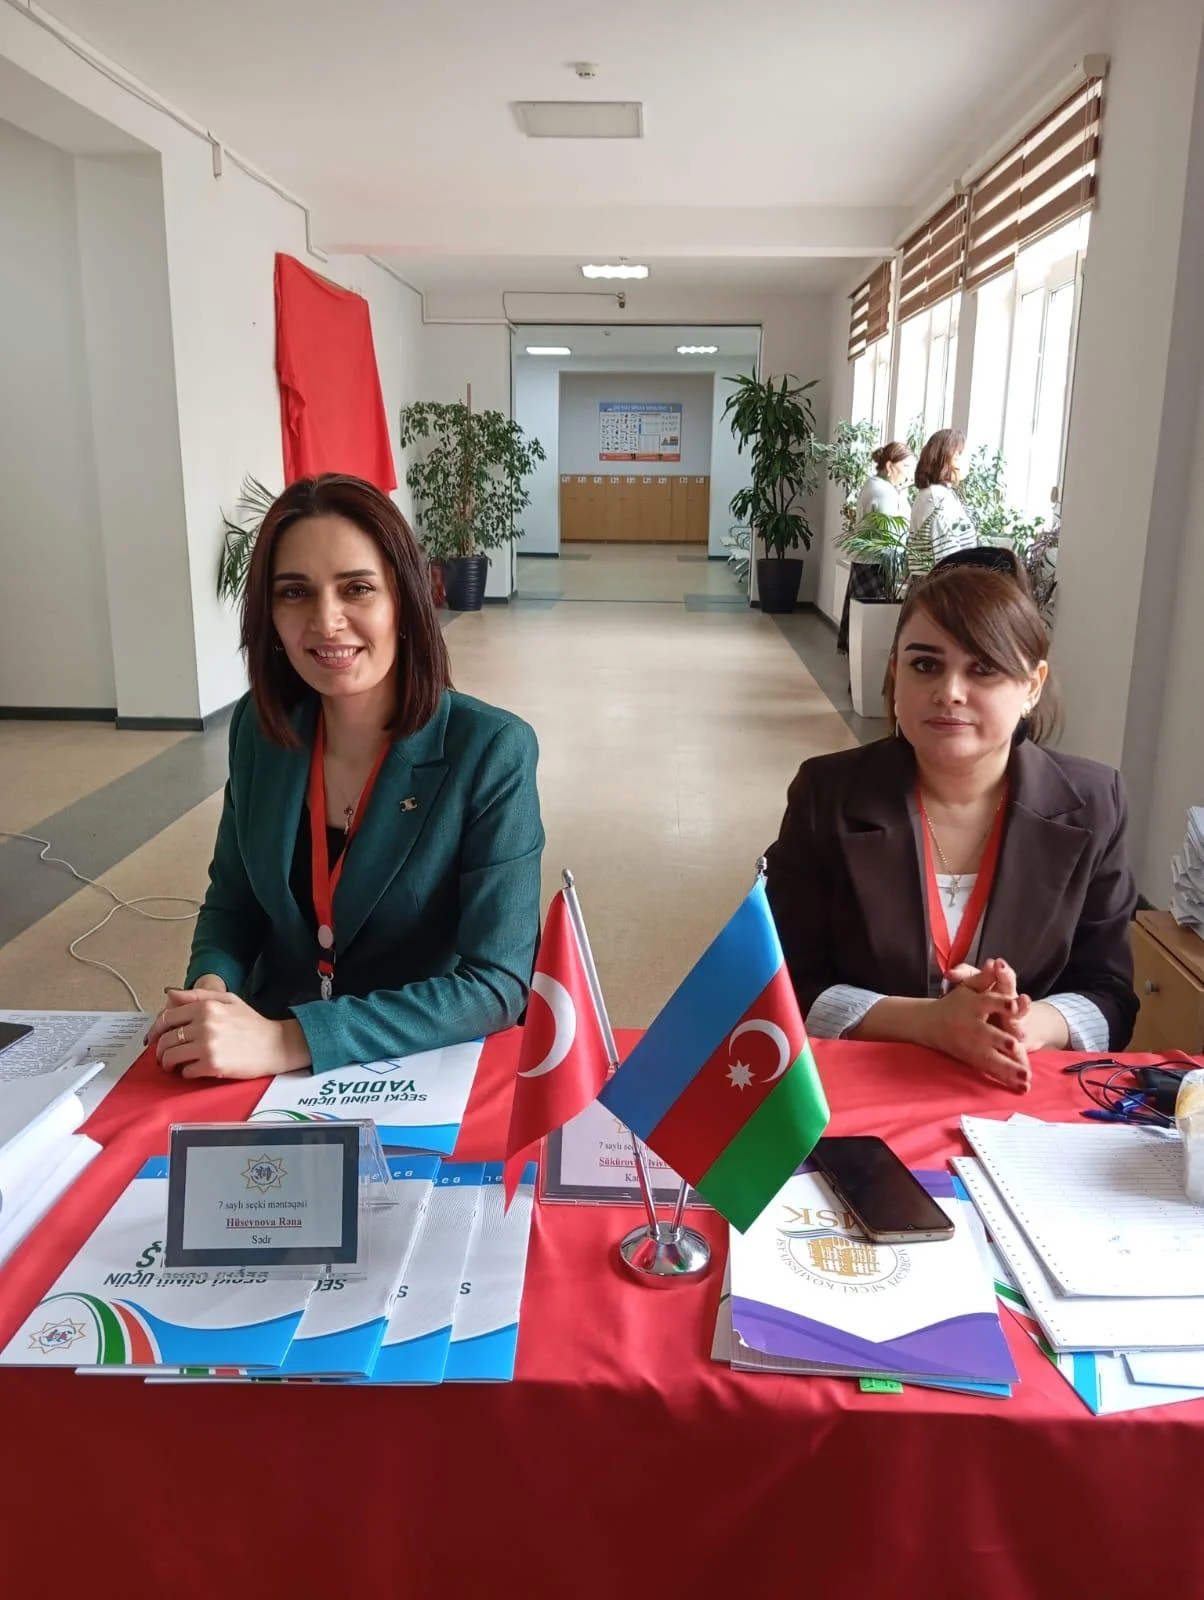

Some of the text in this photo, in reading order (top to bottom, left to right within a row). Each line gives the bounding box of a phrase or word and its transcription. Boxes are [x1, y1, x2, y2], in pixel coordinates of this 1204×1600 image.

[319, 1079, 416, 1096] YADDAŞ
[298, 1092, 428, 1107] SEÇKİ GÜNÜ ÜÇÜN
[218, 1200, 224, 1209] 7
[251, 1234, 272, 1245] Sədr
